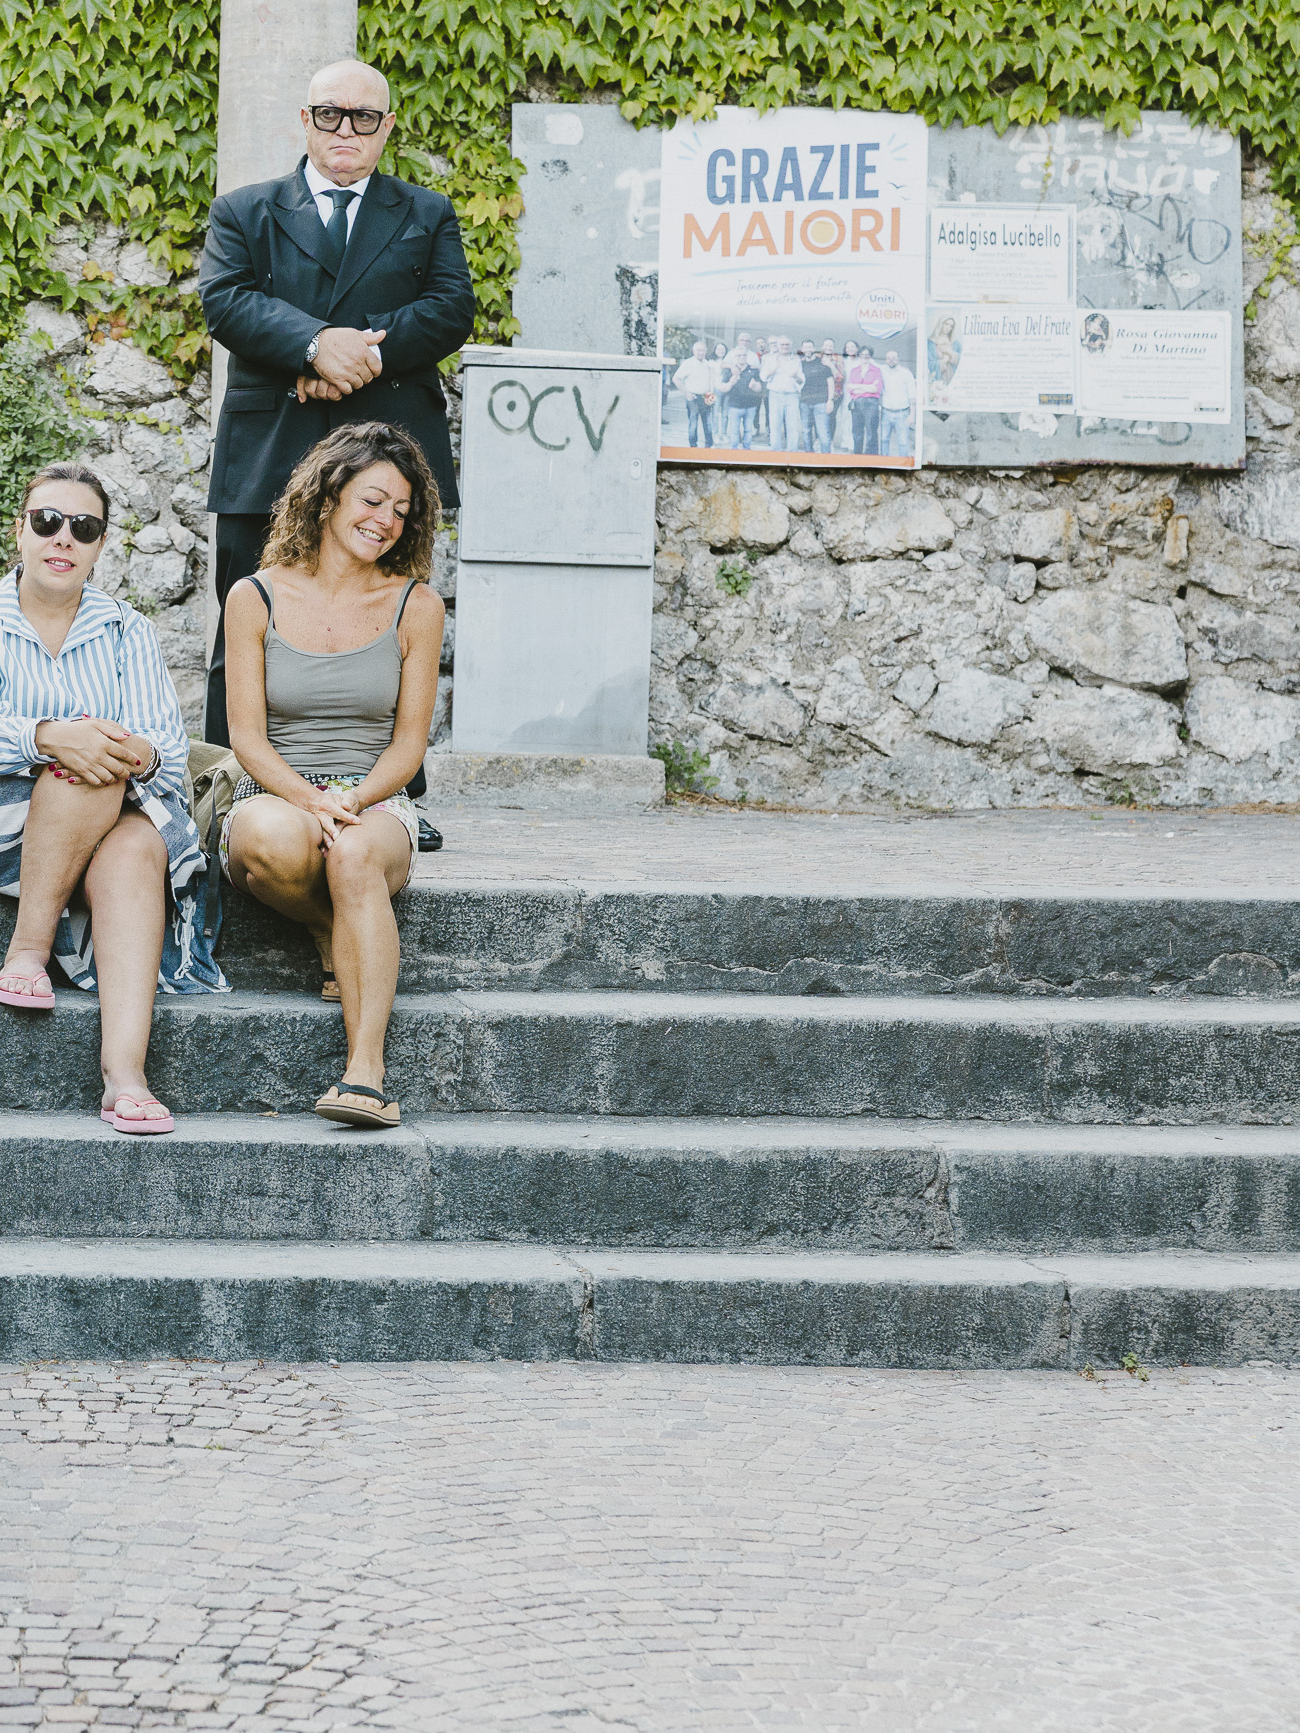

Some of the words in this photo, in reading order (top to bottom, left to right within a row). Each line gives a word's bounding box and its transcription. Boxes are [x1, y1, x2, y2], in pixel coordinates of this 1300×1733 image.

[706, 142, 881, 206] GRAZIE
[683, 207, 901, 259] MAIORI
[938, 221, 997, 251] Adalgisa
[1003, 223, 1061, 248] Lucibello
[780, 282, 797, 293] per
[802, 276, 812, 288] il
[816, 275, 849, 290] futuro
[736, 294, 762, 306] della
[766, 294, 798, 304] nostra
[869, 294, 896, 304] Uniti
[858, 308, 906, 320] MAIORI
[963, 314, 999, 336] Liliana
[1002, 316, 1020, 336] Eva
[1025, 314, 1042, 336] Del
[1044, 315, 1071, 336] Frate
[1116, 328, 1148, 339] Rosa
[1153, 328, 1219, 340] Giovanna
[1132, 343, 1147, 353] Di
[1155, 344, 1207, 354] Martino
